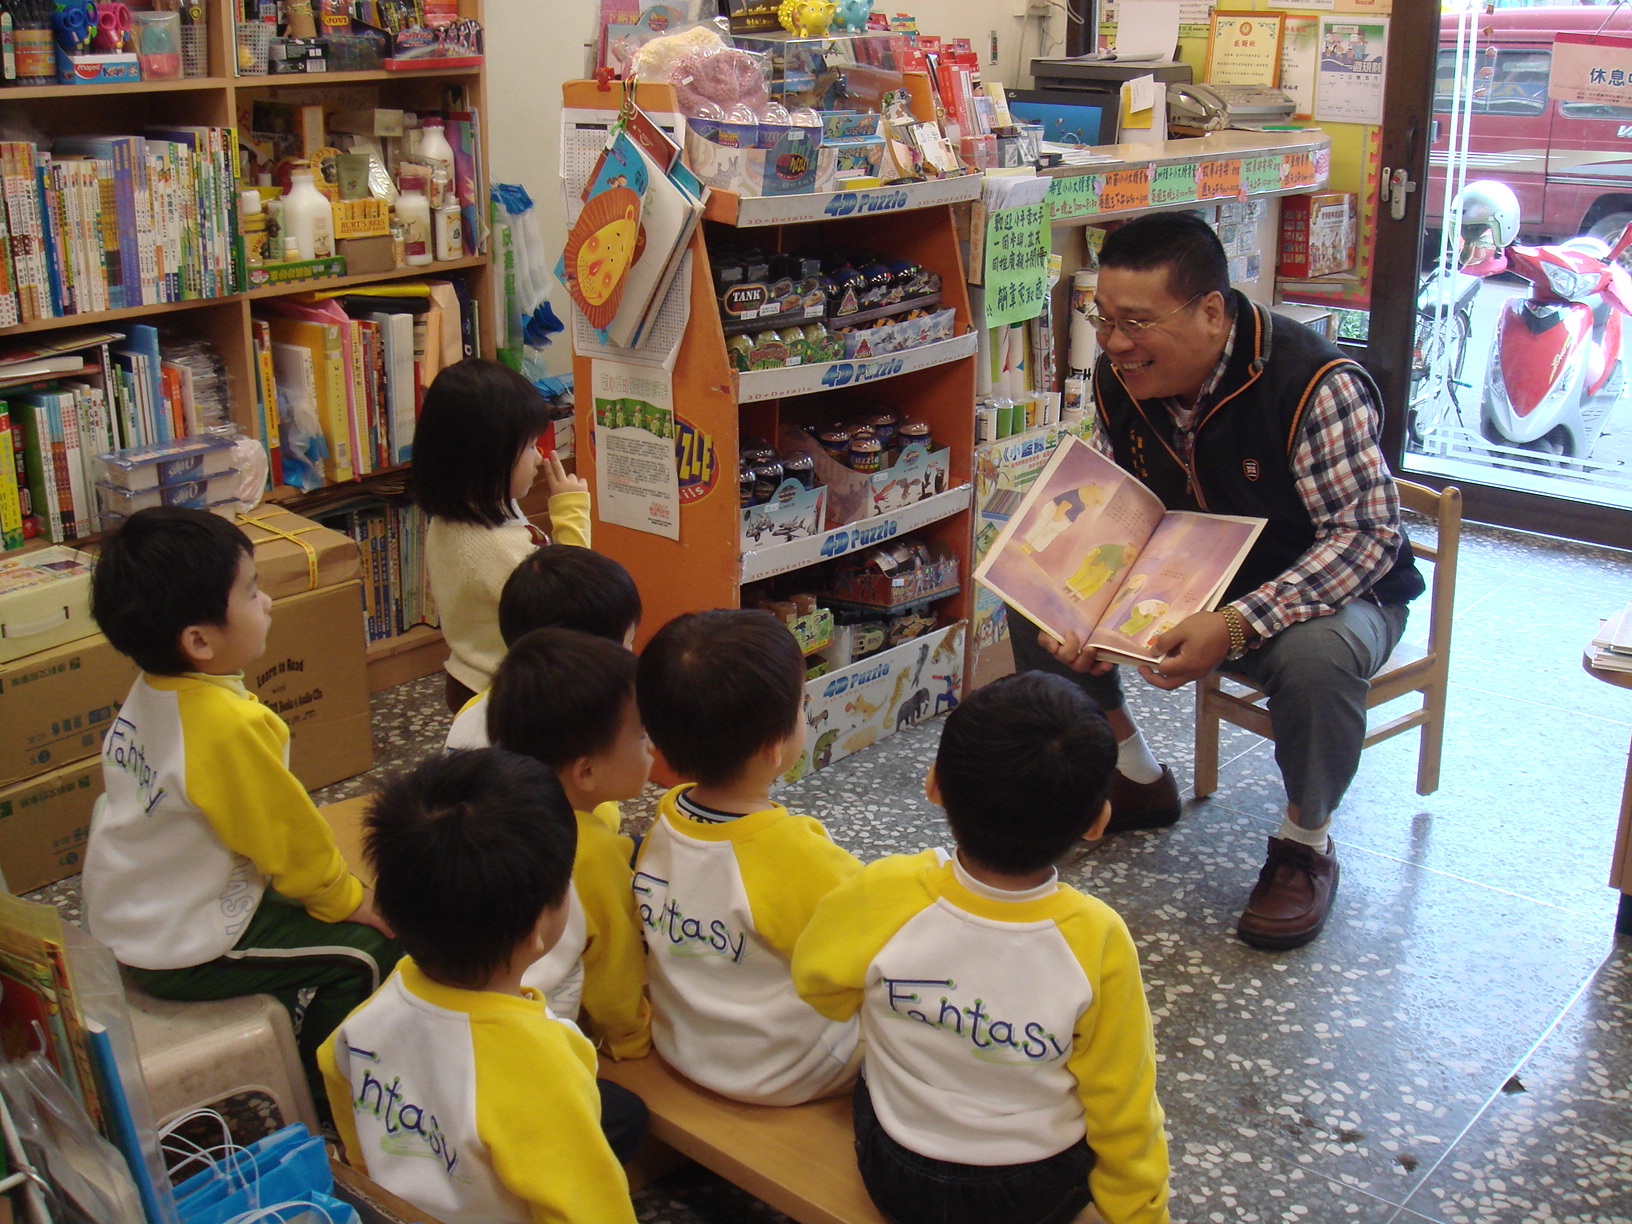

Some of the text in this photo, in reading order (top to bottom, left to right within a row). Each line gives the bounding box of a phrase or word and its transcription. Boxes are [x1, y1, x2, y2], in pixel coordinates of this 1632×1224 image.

[326, 16, 347, 24] JOVI
[77, 64, 101, 73] Maped
[824, 190, 909, 217] 4D Puzzle
[368, 218, 386, 228] BEES
[732, 289, 761, 302] TANK
[821, 358, 904, 387] 4D Puzzle
[675, 424, 713, 483] ZLE
[820, 519, 898, 558] 4D Puzzle
[257, 658, 304, 689] Learn to Read
[823, 663, 891, 698] 4D Puzzle
[883, 978, 1074, 1060] Fantasy
